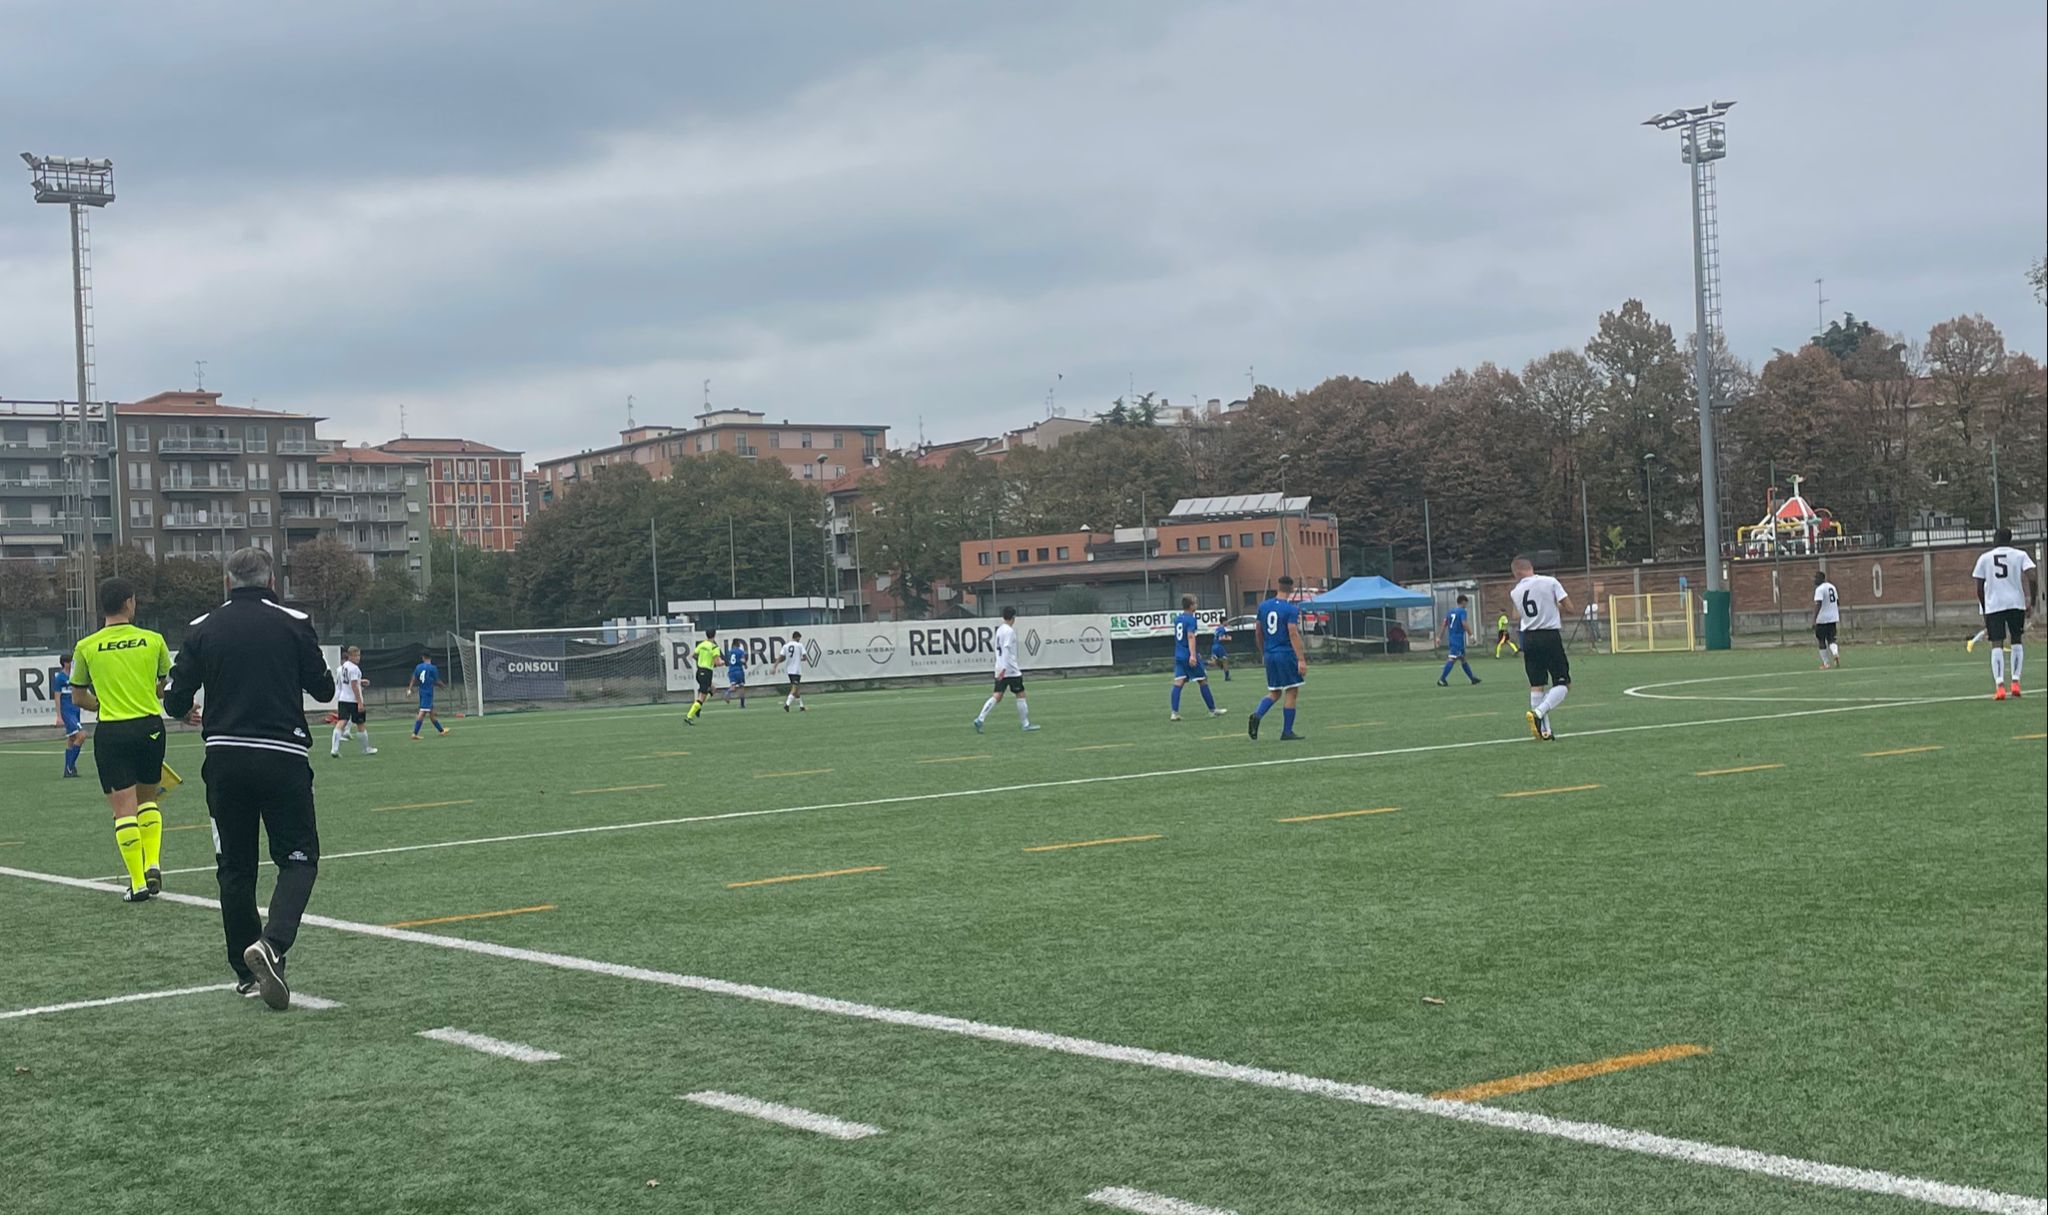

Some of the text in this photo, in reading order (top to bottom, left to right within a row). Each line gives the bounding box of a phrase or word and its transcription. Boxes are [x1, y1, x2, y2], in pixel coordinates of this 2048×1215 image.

[1994, 554, 2008, 579] 5
[1522, 589, 1538, 618] 6
[1128, 613, 1168, 627] SPORT
[1267, 611, 1278, 635] 9
[1449, 613, 1456, 629] 7
[1176, 622, 1183, 641] 8
[97, 638, 147, 652] LEGEA
[909, 626, 999, 656] RENOR
[788, 645, 795, 658] 9
[508, 661, 559, 673] CONSOLI
[419, 669, 427, 684] 4
